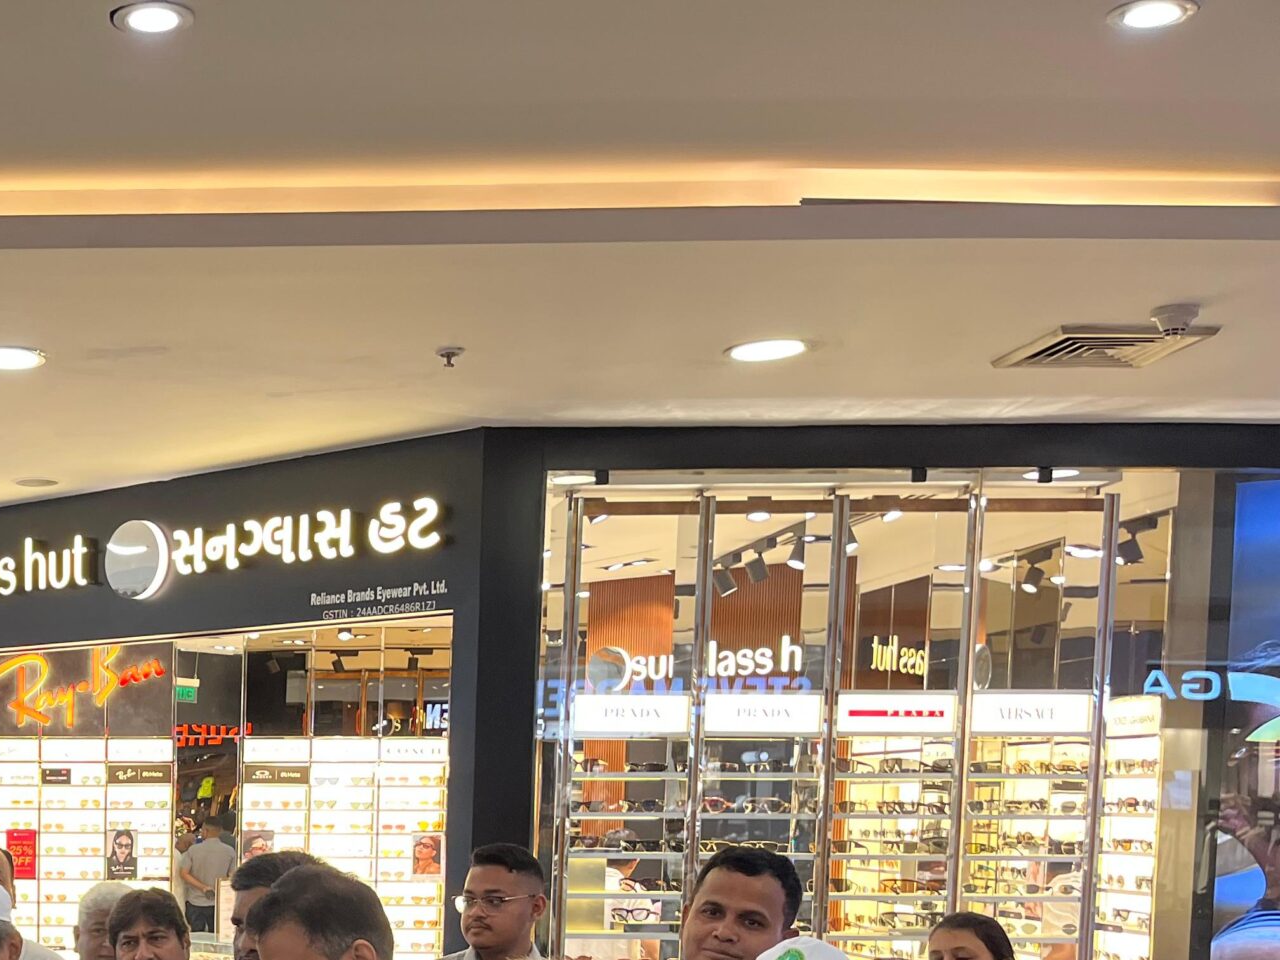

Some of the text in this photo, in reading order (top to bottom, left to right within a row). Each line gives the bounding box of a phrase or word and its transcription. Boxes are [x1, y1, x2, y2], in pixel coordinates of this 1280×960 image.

[172, 497, 441, 575] સનગ્લાસ હટ
[24, 534, 88, 591] hut
[310, 579, 448, 606] Reliance Brands Eyewear Pvt. Ltd.
[322, 609, 348, 620] GSTIN
[604, 707, 661, 718] PRADA
[736, 707, 791, 718] PRADA
